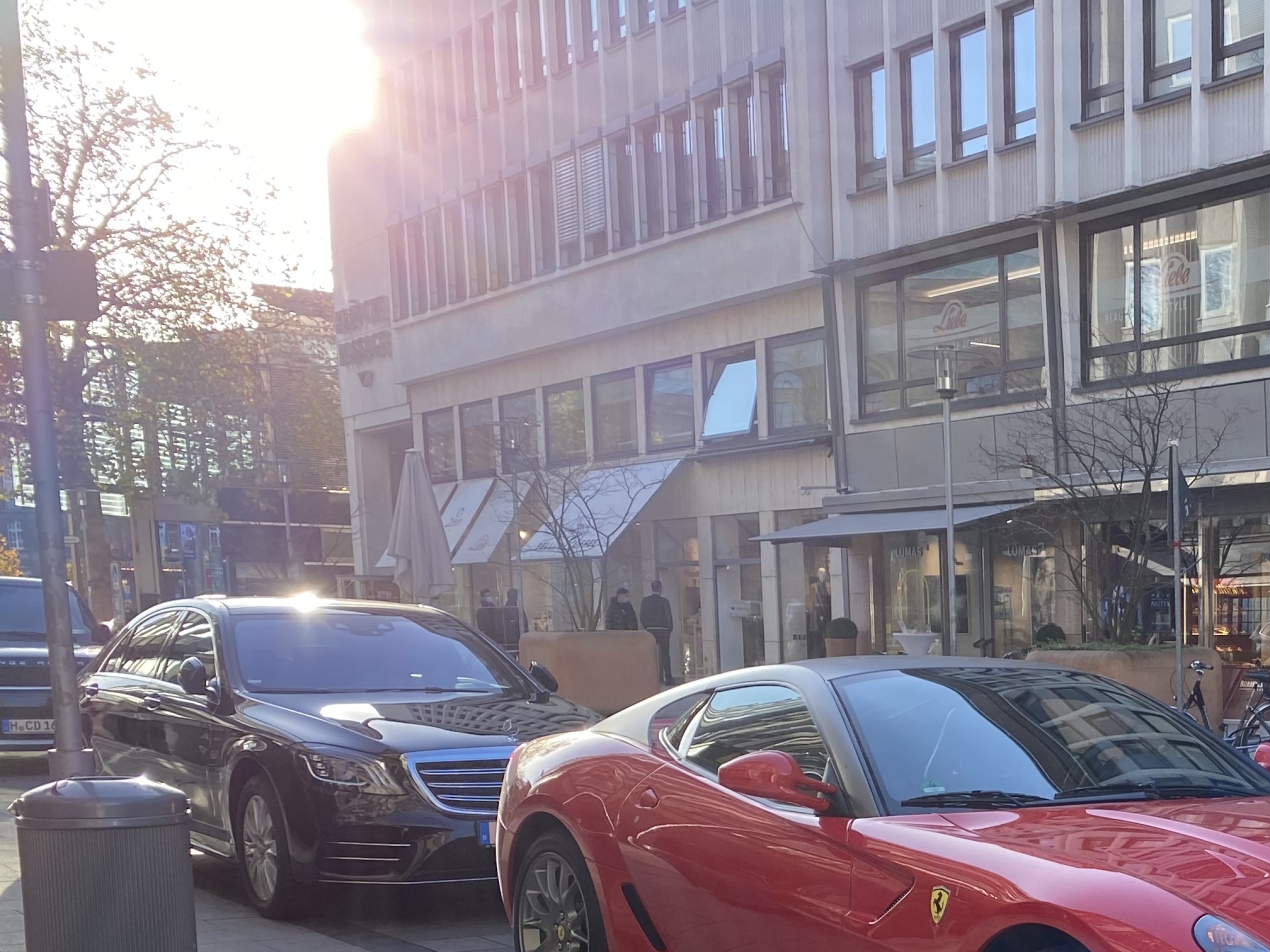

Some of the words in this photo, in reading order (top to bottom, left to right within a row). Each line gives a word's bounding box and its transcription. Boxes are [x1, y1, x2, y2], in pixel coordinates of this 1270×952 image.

[933, 302, 967, 333] Liebe
[895, 546, 923, 558] LUMAS
[10, 721, 18, 731] H
[25, 720, 41, 731] CD
